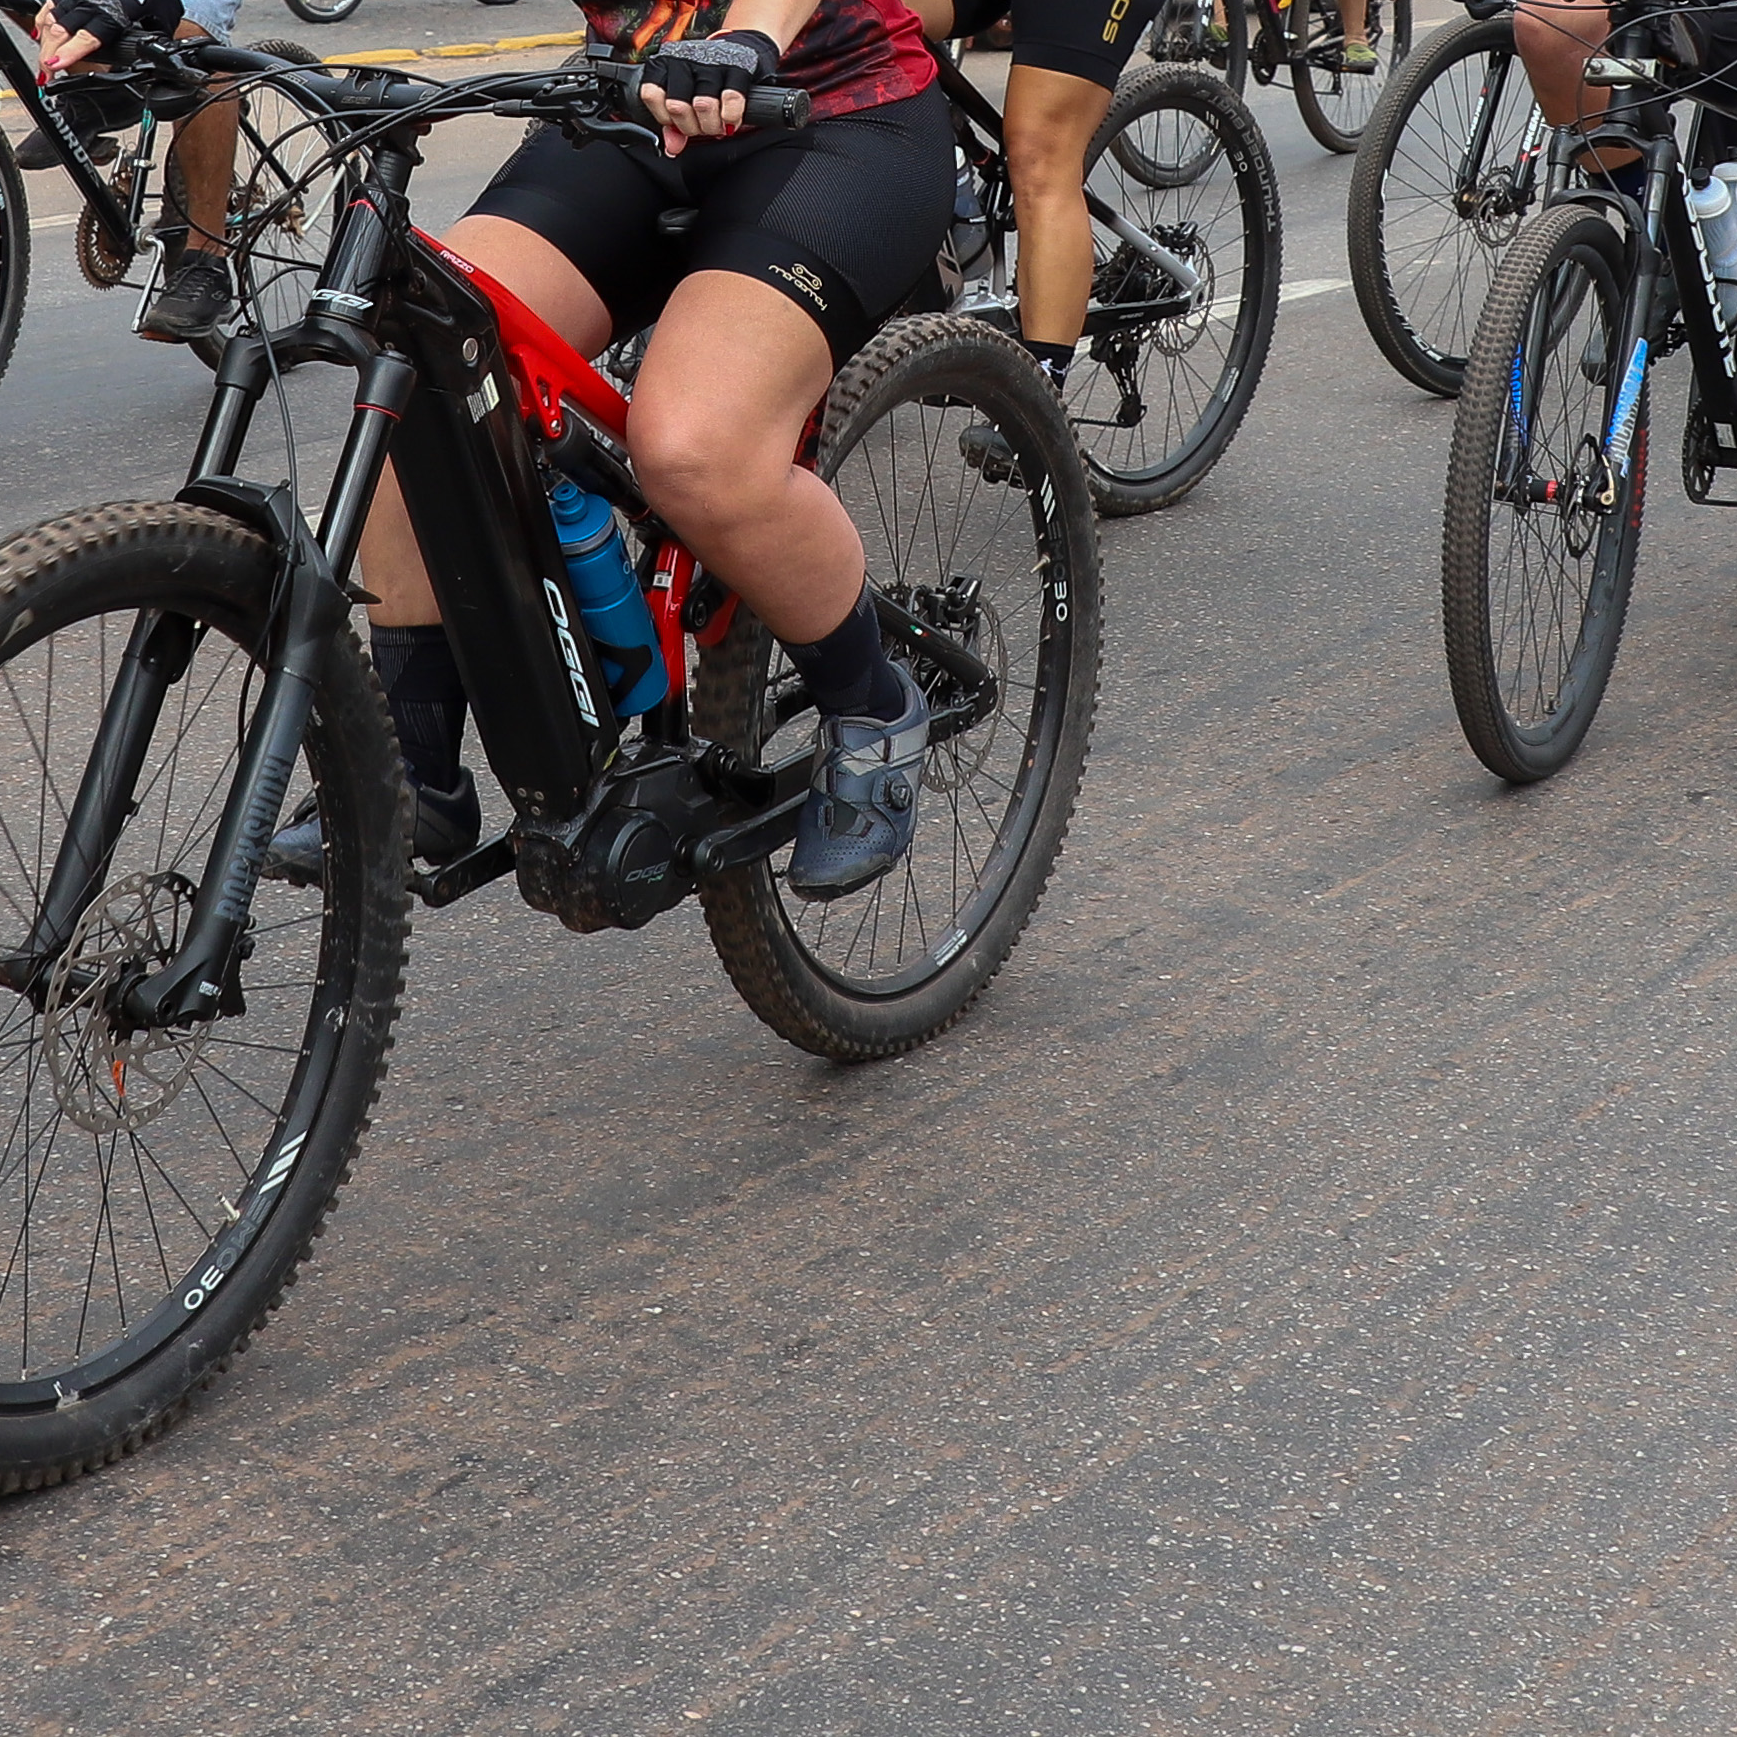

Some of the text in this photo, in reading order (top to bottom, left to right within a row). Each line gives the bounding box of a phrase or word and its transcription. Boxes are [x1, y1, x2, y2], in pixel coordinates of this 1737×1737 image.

[439, 248, 476, 275] MAZZO
[542, 576, 601, 729] OGGI
[213, 755, 293, 926] ROCKSHOX
